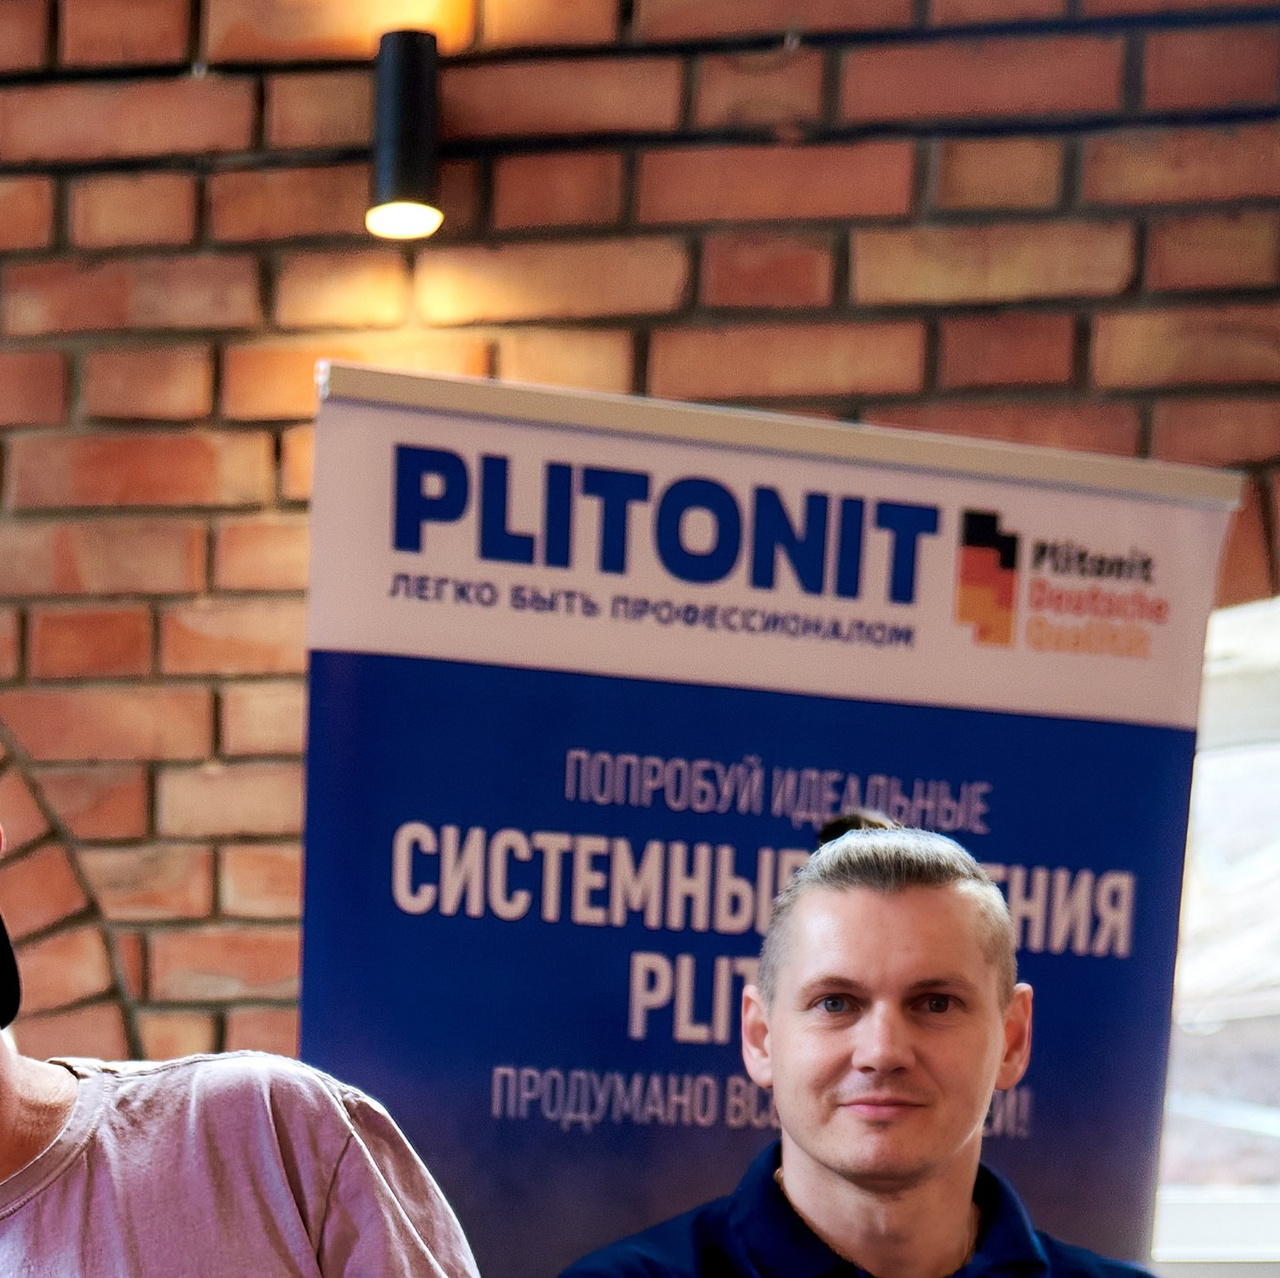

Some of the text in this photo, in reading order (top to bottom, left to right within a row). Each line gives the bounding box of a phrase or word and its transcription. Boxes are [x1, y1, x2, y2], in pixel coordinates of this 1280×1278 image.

[393, 443, 940, 606] PLITONIT
[389, 572, 916, 648] ЛЕГКО БЫТЬ ПРОФЕССИОНАЛОМ
[565, 747, 994, 835] ПОПРОБУЙ ИДЕАЛЬНЫЕ
[491, 1065, 719, 1134] ПРОДУМАНО
